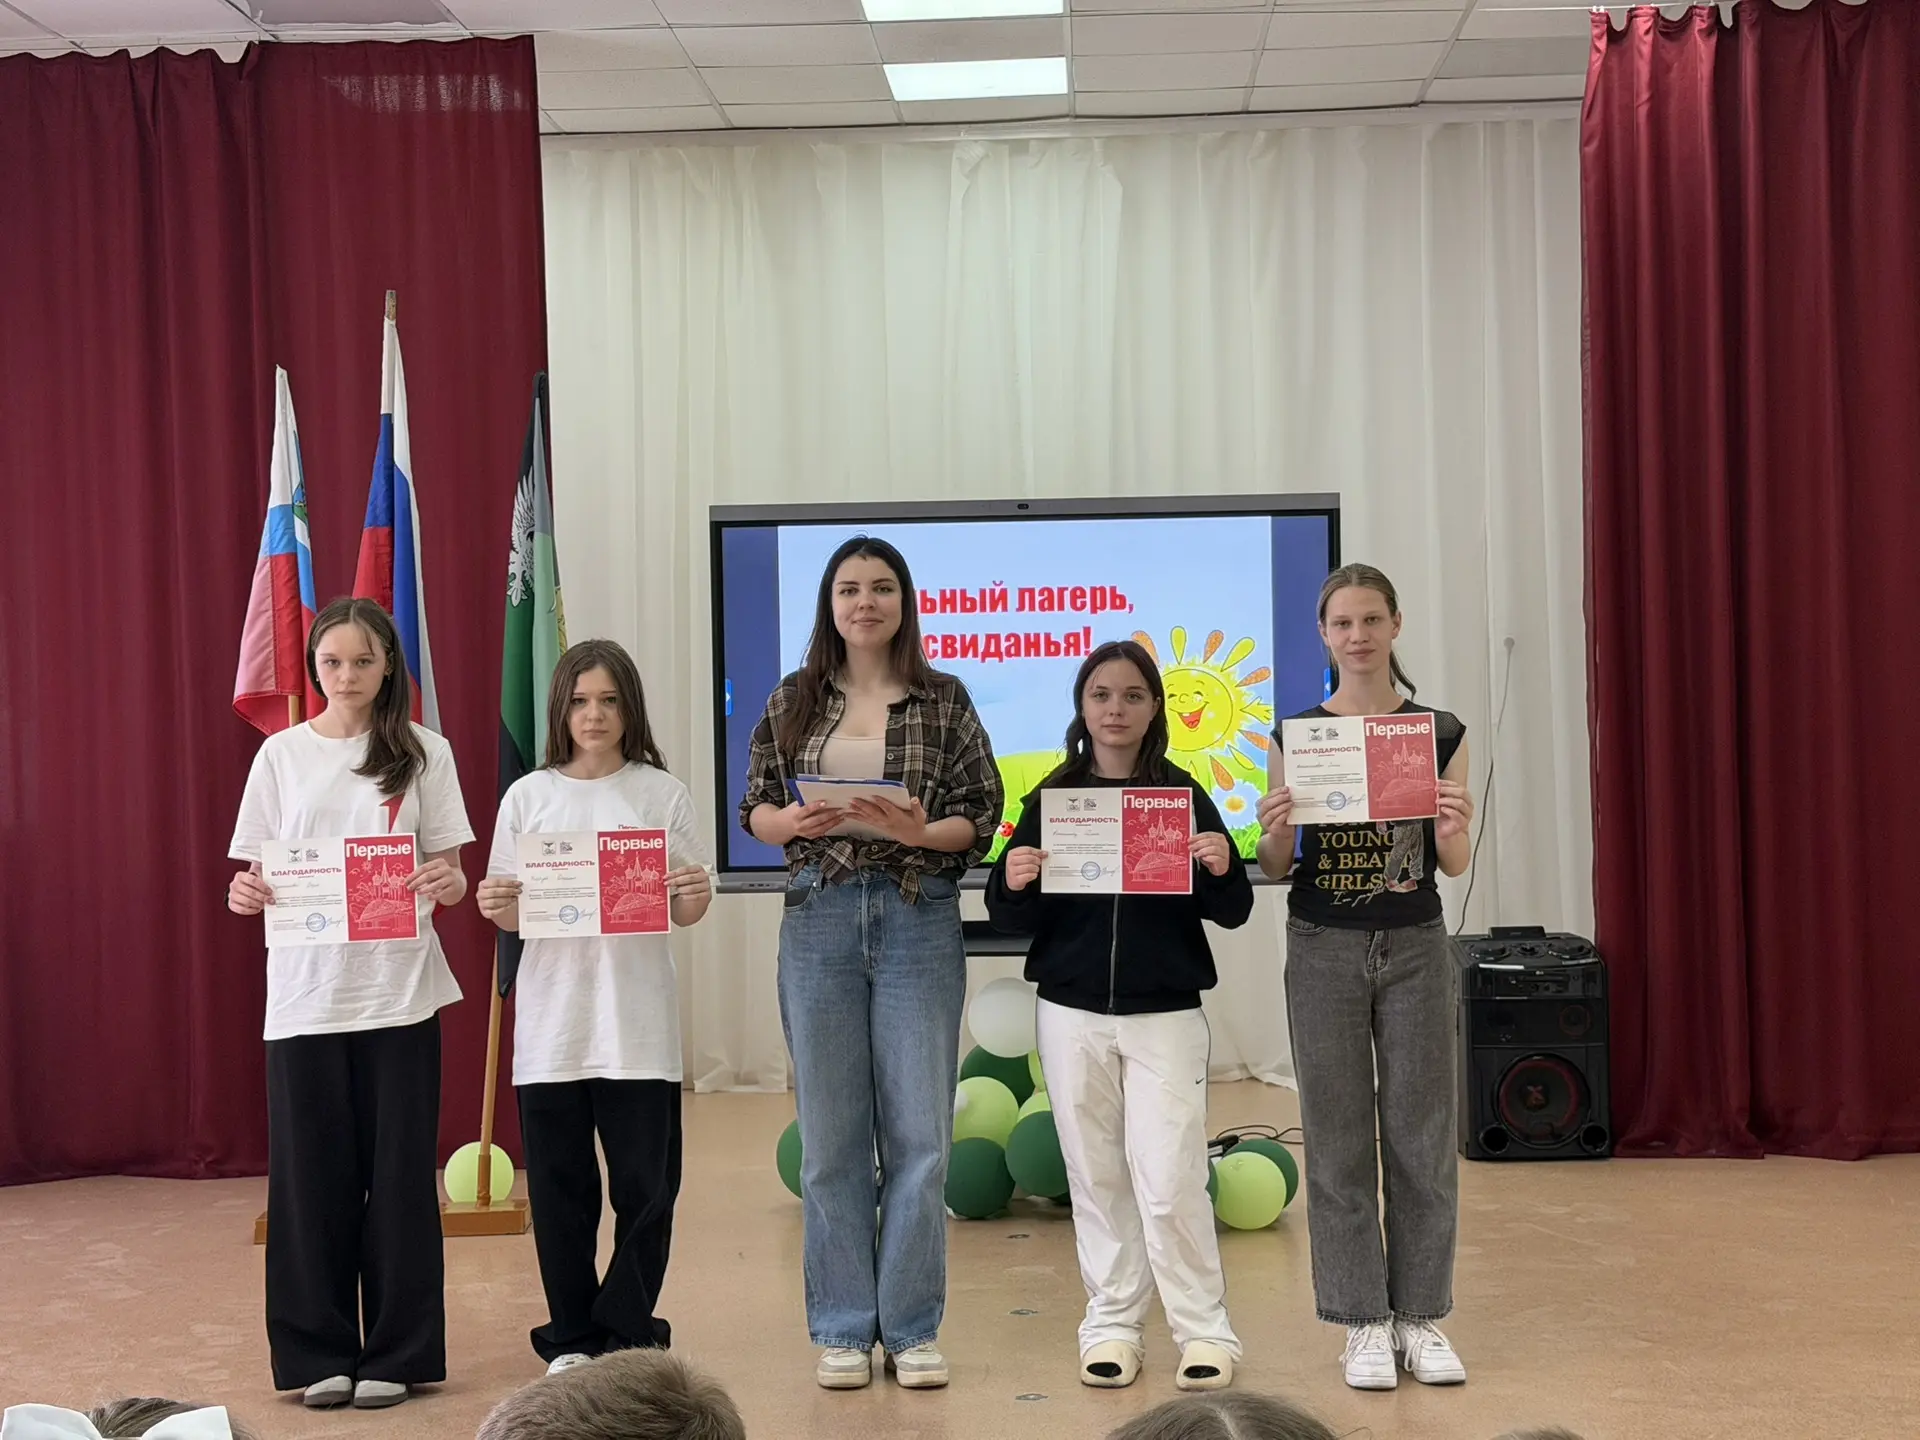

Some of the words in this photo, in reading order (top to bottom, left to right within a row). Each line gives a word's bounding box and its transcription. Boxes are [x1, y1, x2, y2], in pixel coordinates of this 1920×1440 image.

[915, 580, 1008, 614] ьный
[1015, 585, 1134, 614] лагерь,
[923, 626, 1092, 663] свиданья!
[1365, 722, 1430, 739] Первые
[1292, 746, 1361, 755] БЛАГОДАРНОСТЬ
[1123, 795, 1188, 812] Первые
[346, 843, 412, 860] Первые
[600, 836, 664, 854] Первые
[525, 860, 595, 869] БЛАГОДАРНОСТЬ
[1317, 853, 1332, 870] &
[271, 867, 342, 877] БЛАГОДАРНОСТЬ
[1315, 873, 1384, 890] GIRLS
